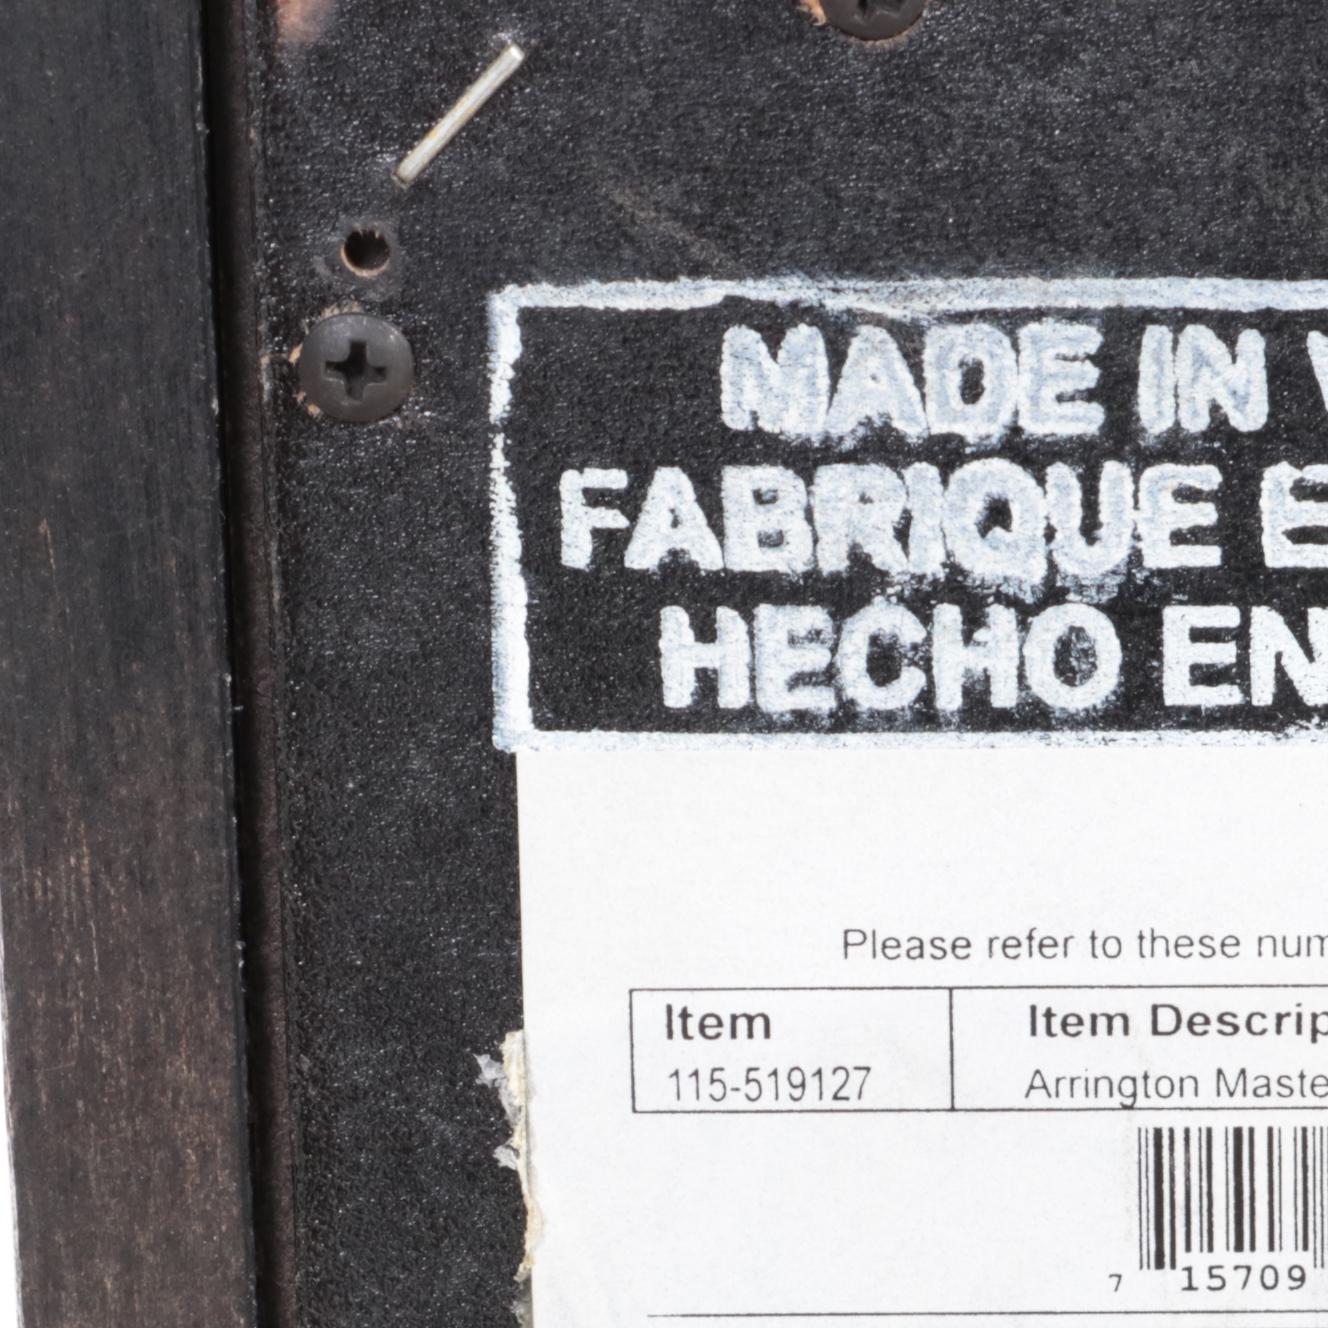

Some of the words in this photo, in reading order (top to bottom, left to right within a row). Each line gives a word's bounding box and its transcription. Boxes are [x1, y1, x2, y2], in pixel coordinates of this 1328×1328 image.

[720, 324, 1103, 438] MADE
[1140, 327, 1270, 432] IN
[560, 458, 1223, 578] FABRIQUE
[659, 601, 1125, 714] HECHO
[844, 929, 971, 960] Please
[989, 928, 1074, 960] refer
[1090, 931, 1121, 958] to
[1138, 928, 1240, 959] these
[666, 1004, 770, 1040] Item
[1030, 1004, 1129, 1037] Item
[669, 1066, 871, 1102] 115-519127
[1025, 1069, 1198, 1104] Arrington
[1109, 1274, 1122, 1292] 7
[1182, 1266, 1306, 1291] 15709
